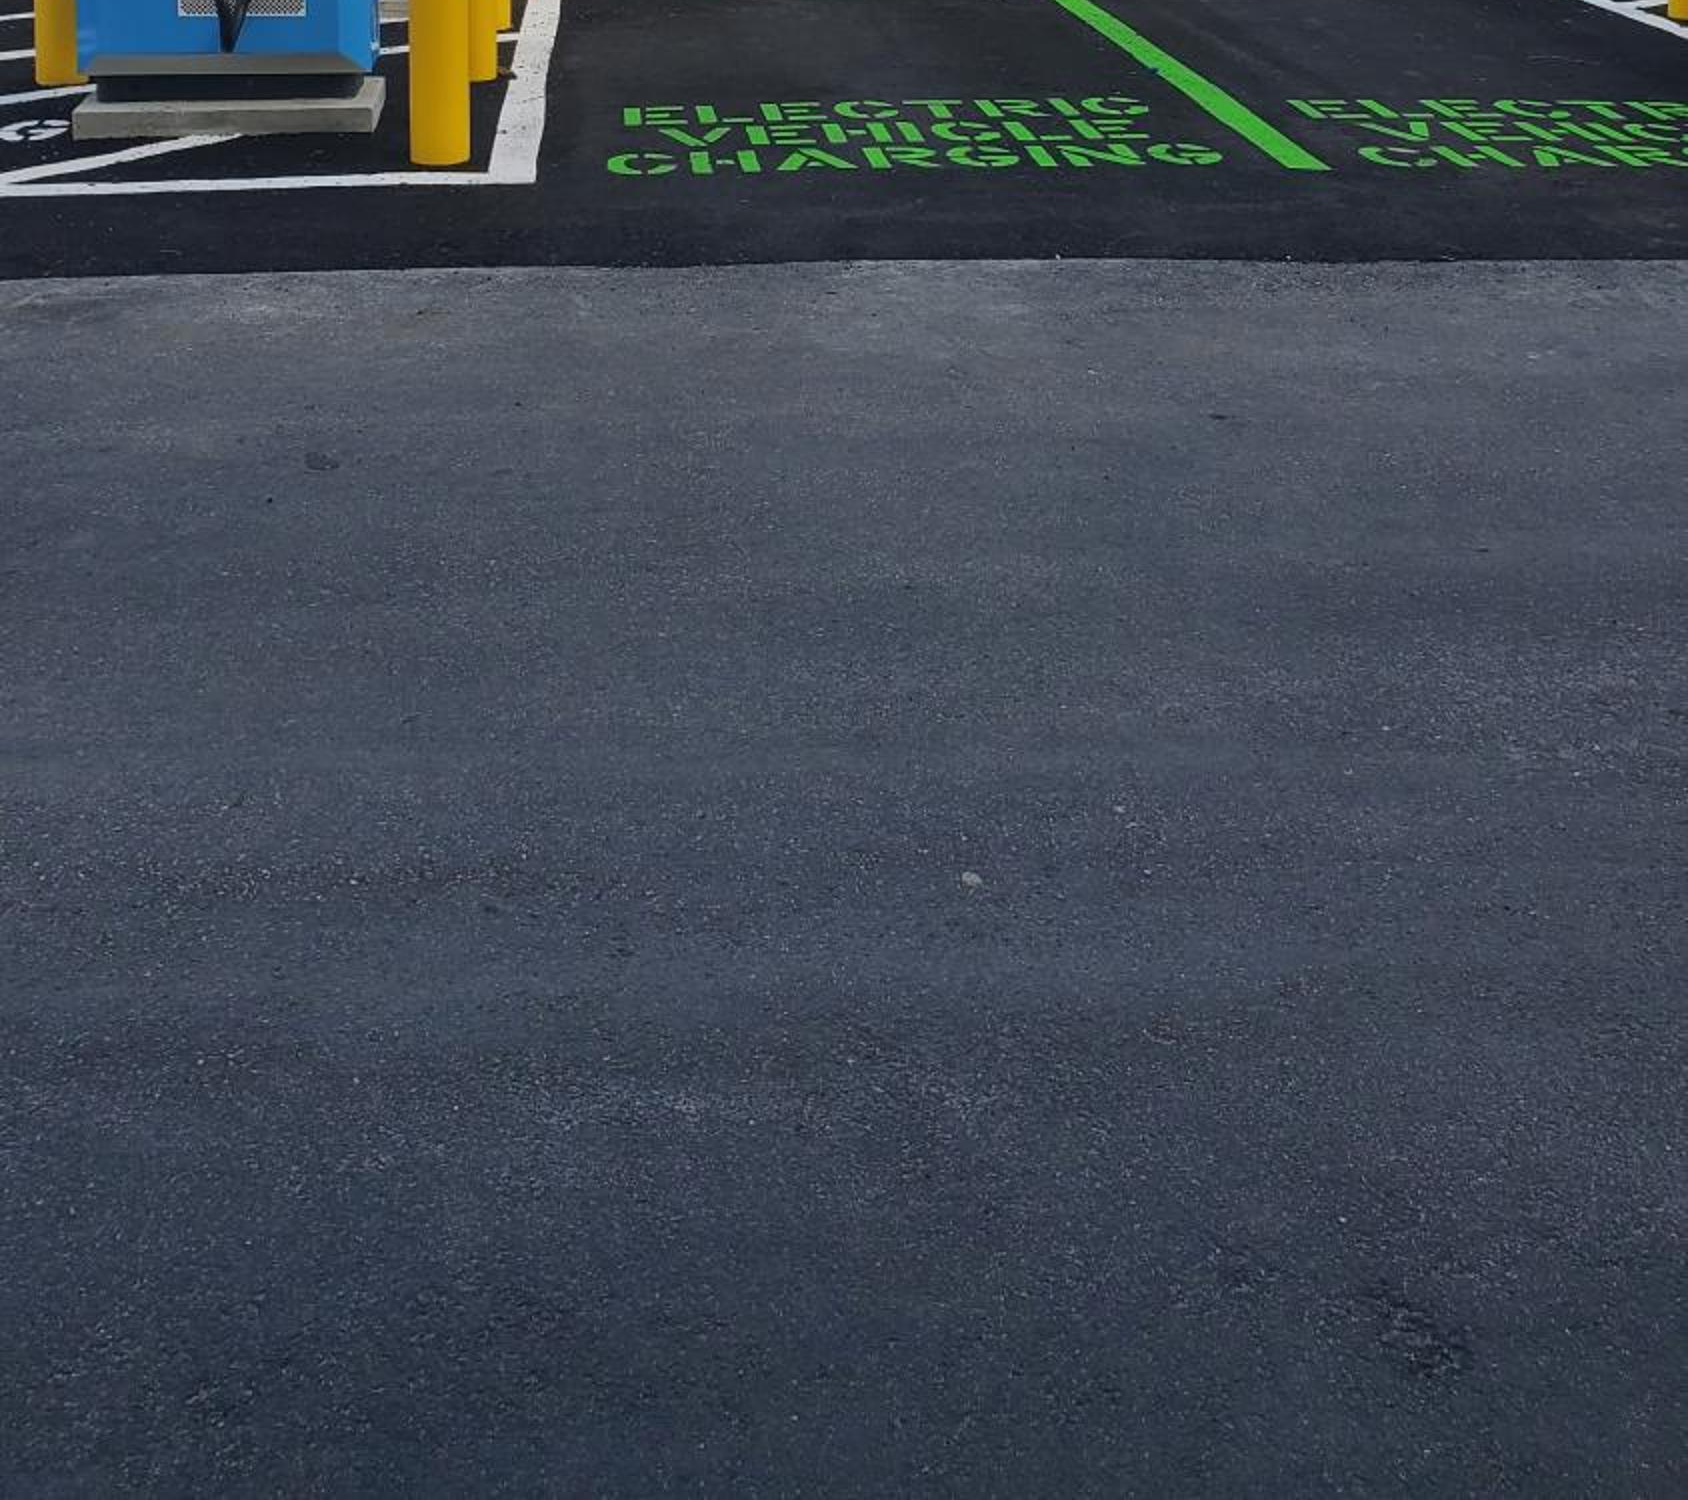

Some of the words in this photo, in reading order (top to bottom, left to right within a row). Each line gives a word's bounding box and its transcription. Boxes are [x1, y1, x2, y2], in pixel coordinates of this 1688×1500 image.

[623, 97, 1149, 126] ELECTRIC
[658, 119, 1149, 147] VEHICLE
[607, 143, 1223, 175] CHARGING
[1358, 144, 1688, 167] CHAR
